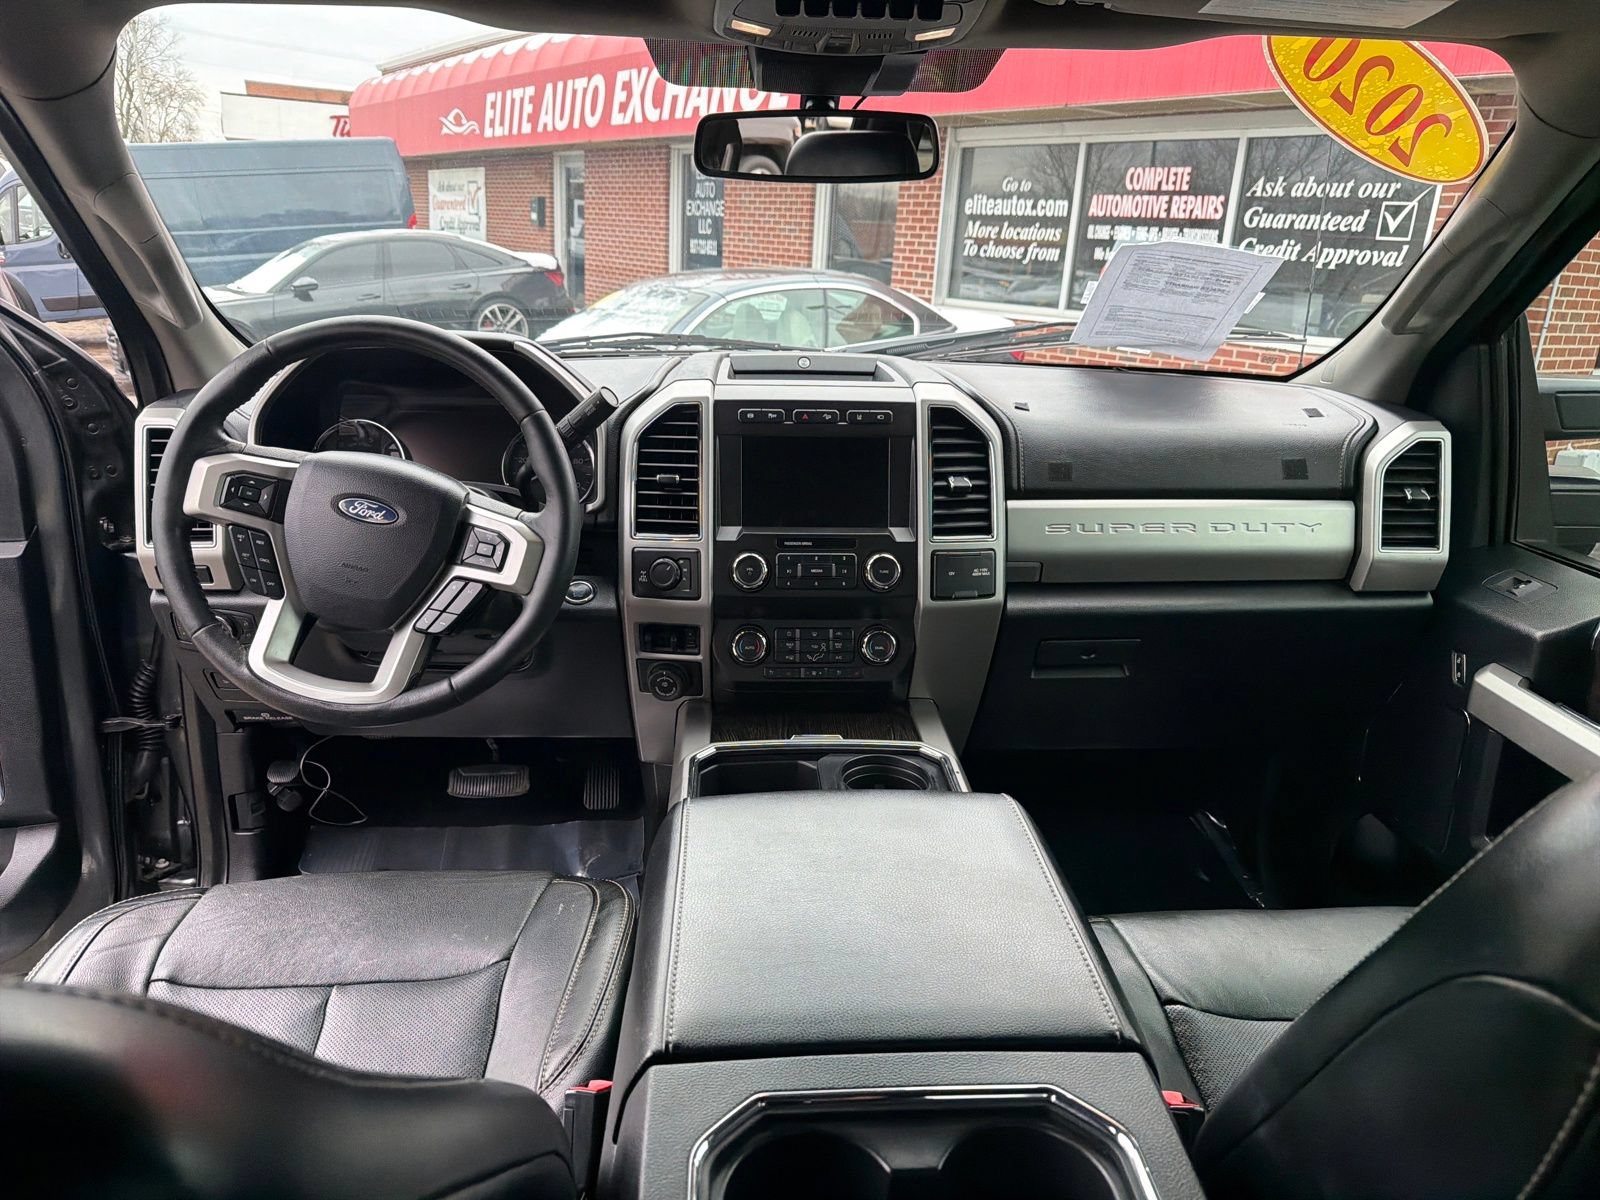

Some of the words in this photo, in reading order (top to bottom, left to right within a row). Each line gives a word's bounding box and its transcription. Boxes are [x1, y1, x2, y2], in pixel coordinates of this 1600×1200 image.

[483, 84, 535, 138] ELITE
[537, 73, 606, 131] AUTO
[695, 181, 716, 198] AUTO
[1002, 177, 1018, 192] Go
[1020, 179, 1032, 192] to
[1125, 166, 1192, 191] COMPLETE
[1246, 175, 1287, 198] Ask
[1291, 175, 1355, 199] about
[1358, 181, 1402, 199] our
[686, 200, 725, 217] EXCHANGE
[964, 193, 1069, 217] eliteautox.com
[1088, 194, 1169, 219] AUTOMOTIVE
[1169, 195, 1226, 220] REPAIRS
[697, 218, 712, 235] LLC
[964, 220, 999, 239] More
[1000, 221, 1062, 241] locations
[1243, 206, 1371, 233] Guaranteed
[963, 239, 978, 257] To
[980, 240, 1025, 259] choose
[1022, 242, 1060, 264] from
[1239, 237, 1302, 262] Credit
[1301, 241, 1410, 270] Approval
[348, 500, 386, 520] Ford
[1045, 522, 1197, 536] SUPER
[1208, 521, 1323, 535] DUTY
